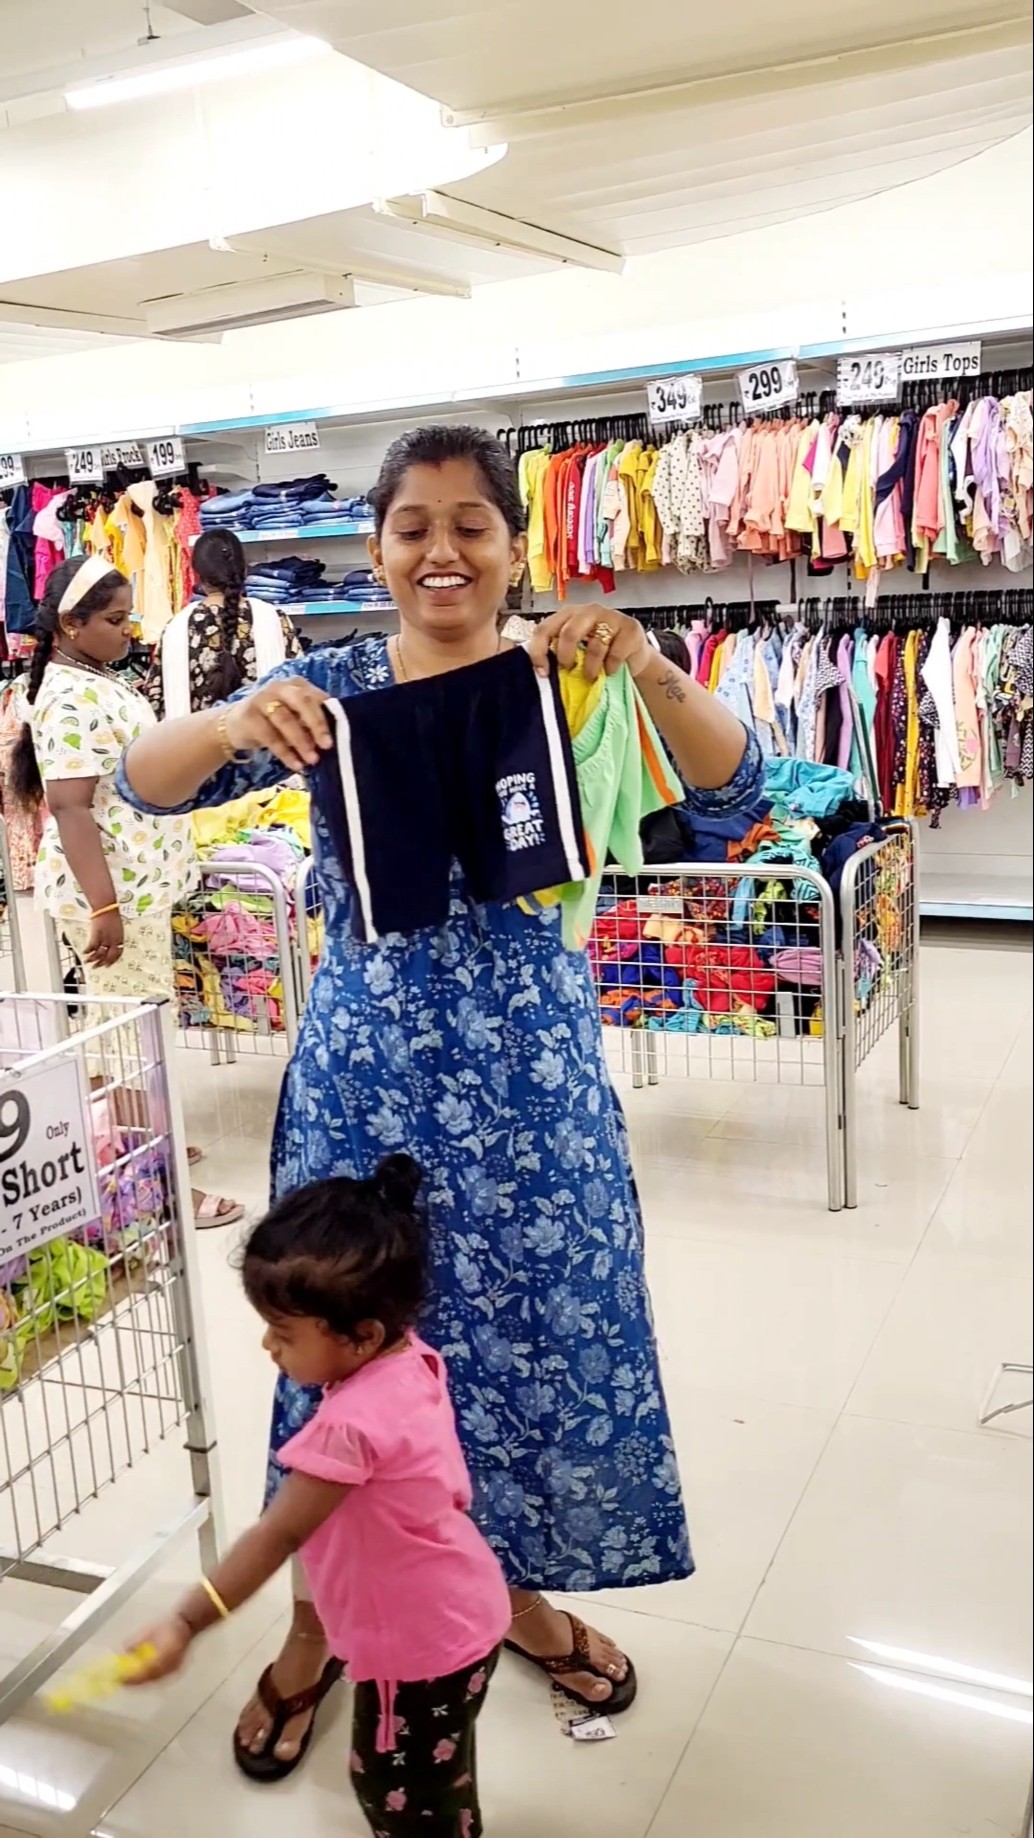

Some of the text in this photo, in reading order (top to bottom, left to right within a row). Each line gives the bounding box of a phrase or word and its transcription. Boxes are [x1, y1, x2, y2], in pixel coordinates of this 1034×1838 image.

[850, 360, 885, 391] 249
[903, 353, 980, 376] Girls Tops
[748, 366, 783, 401] 299
[656, 385, 688, 413] 349
[152, 441, 175, 467] 199
[266, 430, 319, 451] Girls Jeans
[73, 450, 94, 474] 249
[503, 819, 544, 842] GREAT
[46, 1120, 70, 1141] Only
[1, 1141, 85, 1208] Short
[12, 1212, 23, 1231] 7
[28, 1186, 82, 1222] Years)
[16, 1233, 37, 1247] The
[40, 1207, 87, 1236] Product)
